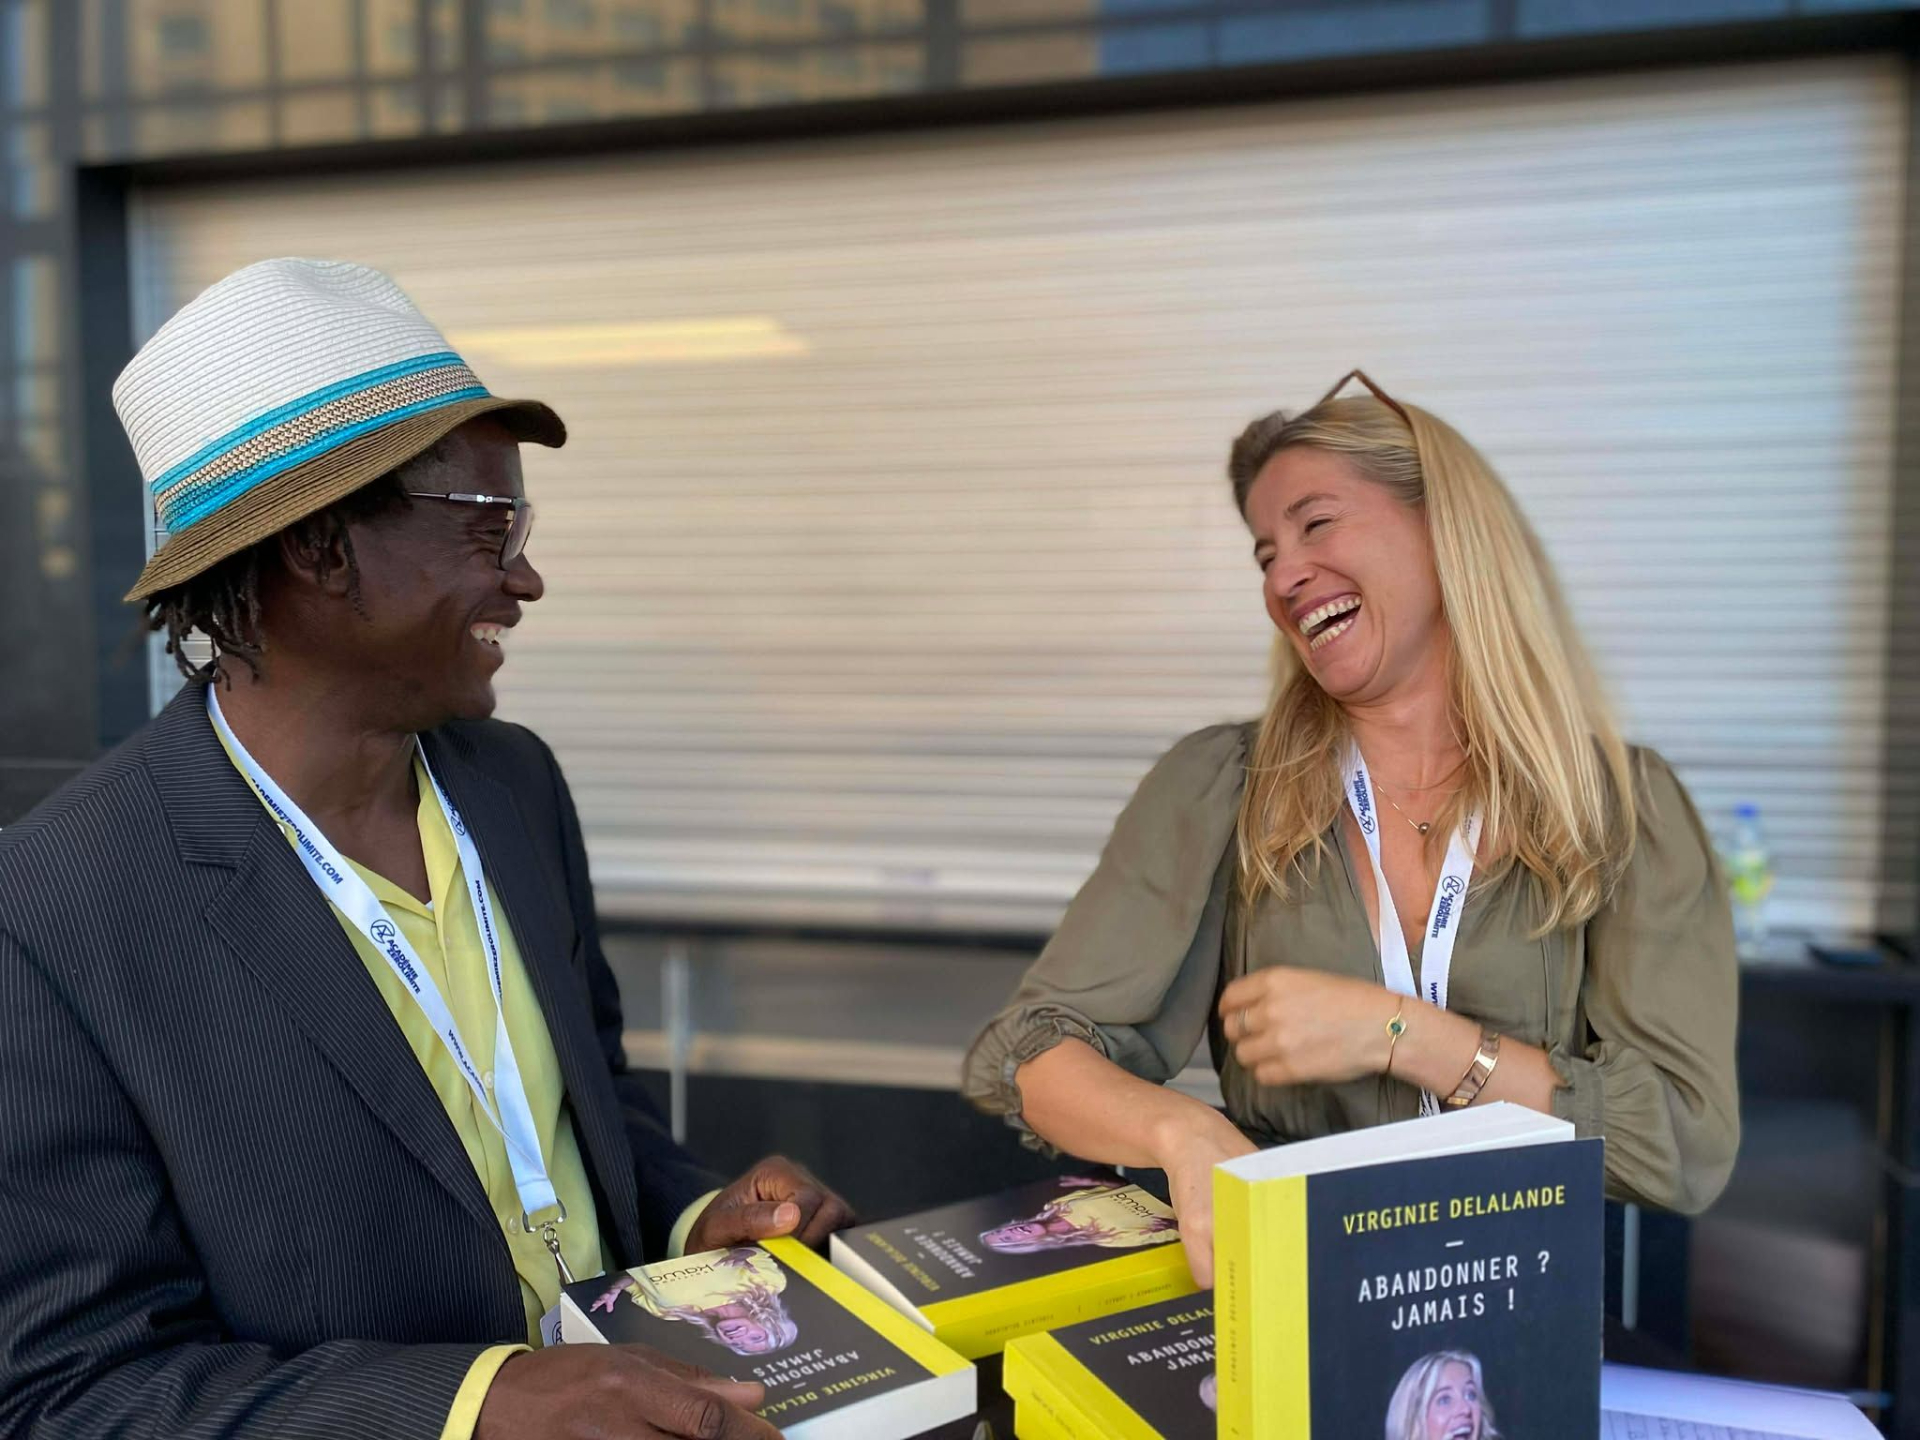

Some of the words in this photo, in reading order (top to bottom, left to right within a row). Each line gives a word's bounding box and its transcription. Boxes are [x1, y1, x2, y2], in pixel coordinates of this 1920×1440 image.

[386, 949, 421, 994] ZEROLIMITE
[387, 938, 419, 980] ACADÉMIE
[1343, 1202, 1440, 1235] VIRGINIE
[1449, 1185, 1565, 1220] DELALANDE
[1358, 1255, 1519, 1302] ABANDONNER
[1537, 1250, 1550, 1274] ?
[1391, 1292, 1485, 1330] JAMAIS
[1506, 1288, 1515, 1310] !
[1089, 1320, 1164, 1345] VIRGINIE
[752, 1349, 823, 1377] JAMAIS
[821, 1366, 896, 1396] VIRGINIE
